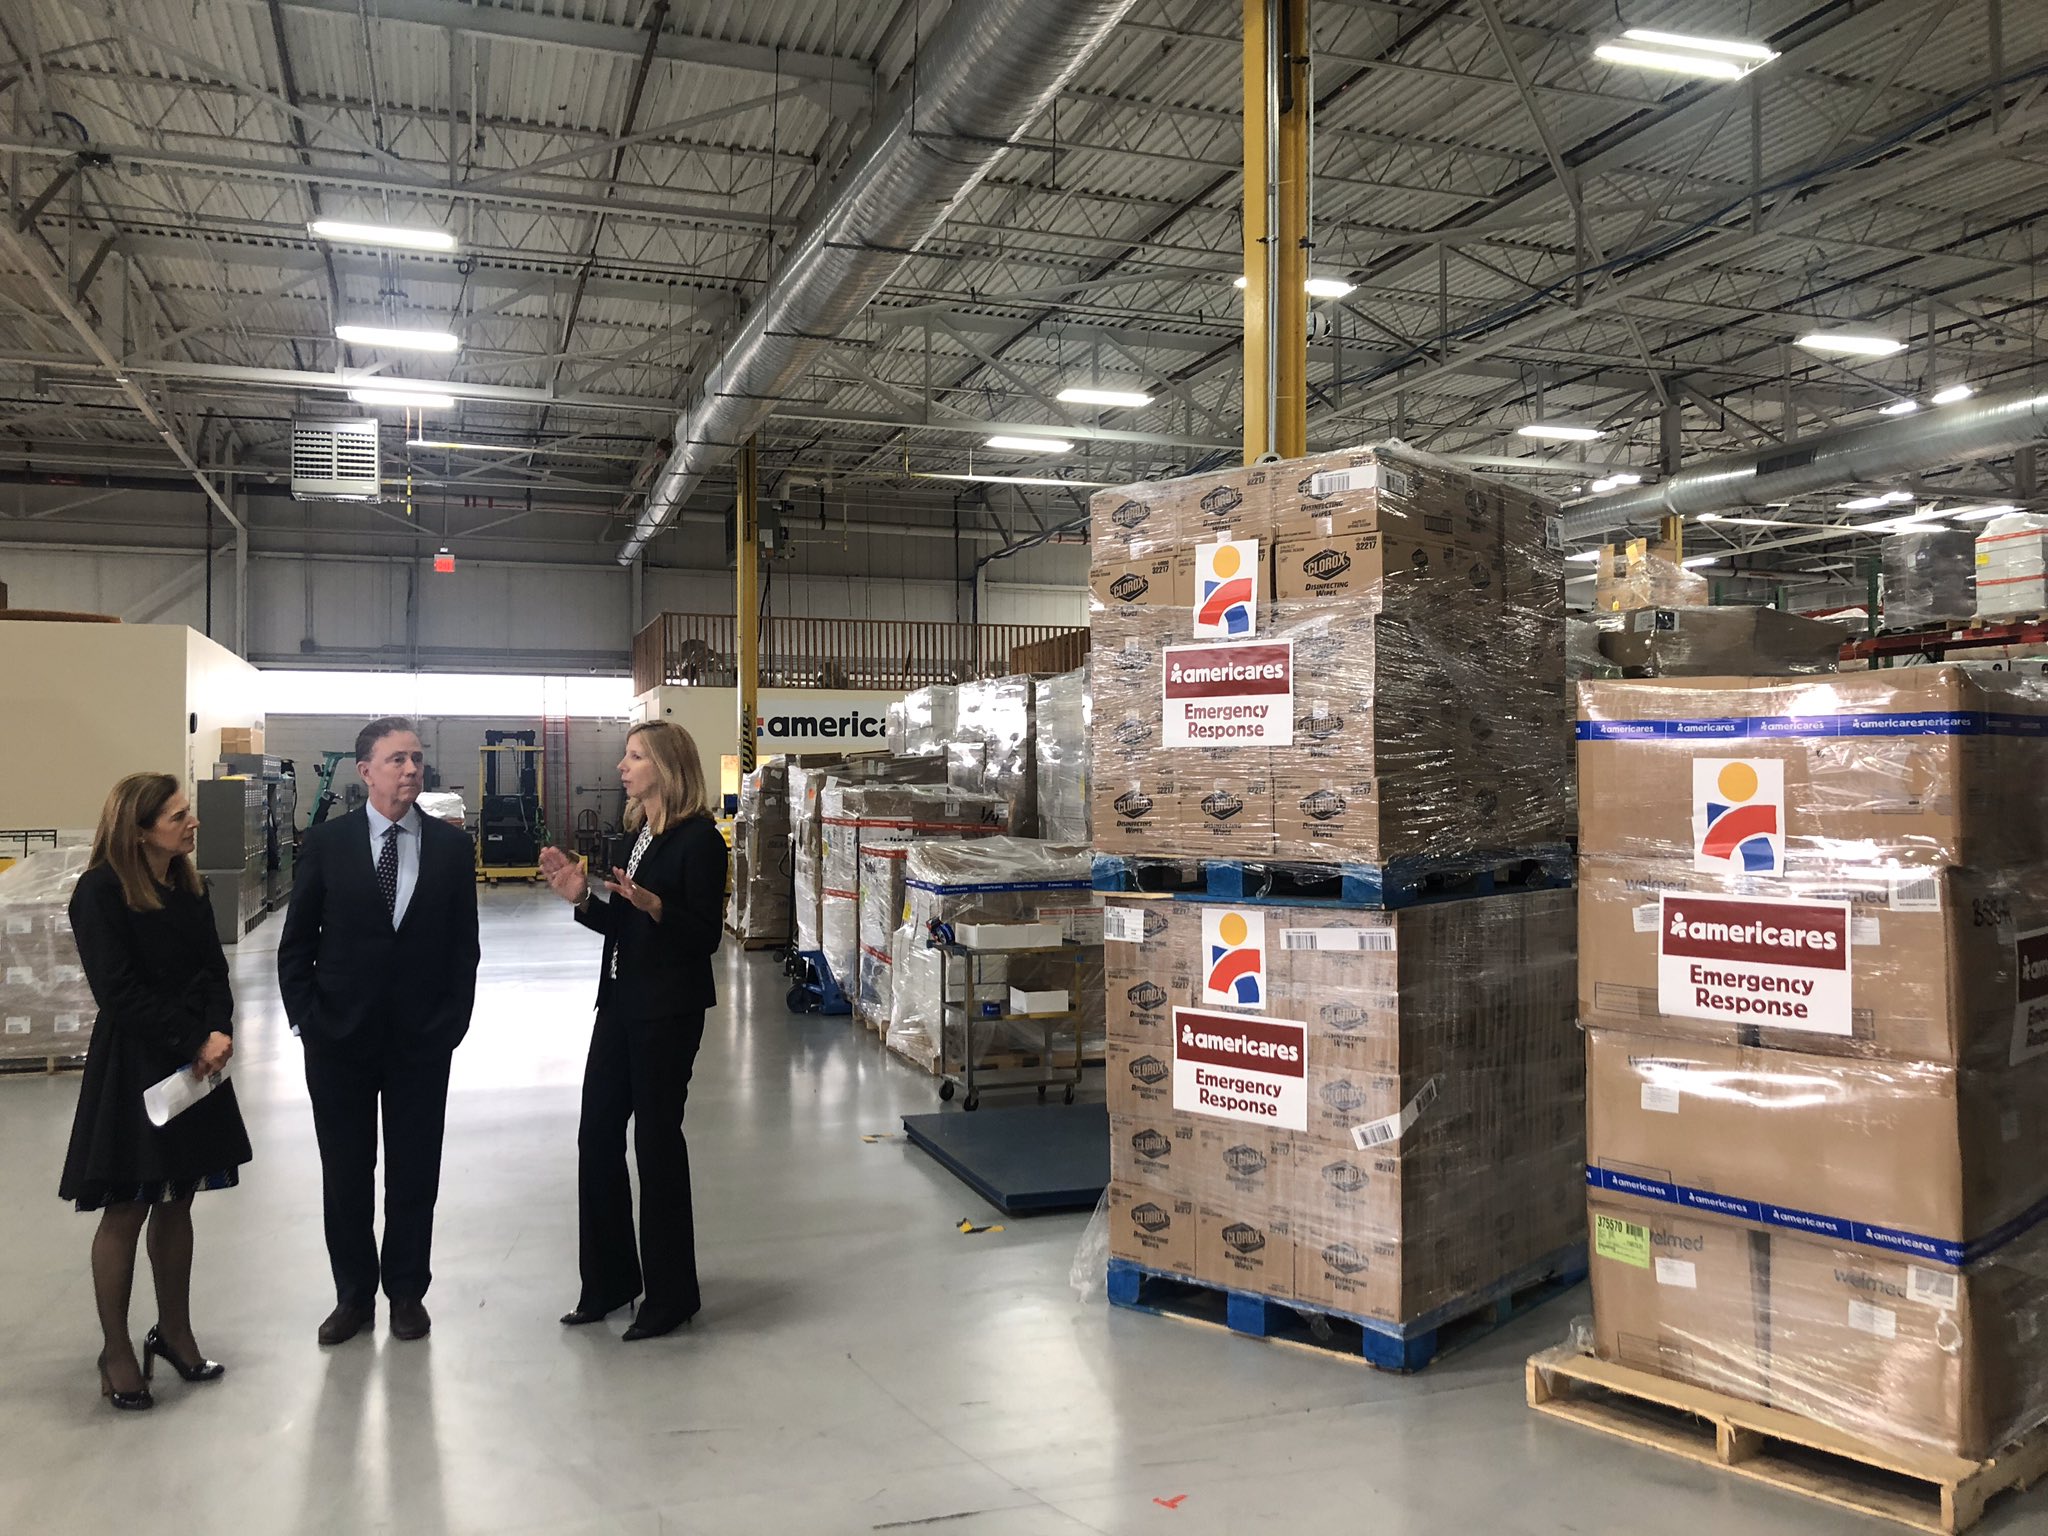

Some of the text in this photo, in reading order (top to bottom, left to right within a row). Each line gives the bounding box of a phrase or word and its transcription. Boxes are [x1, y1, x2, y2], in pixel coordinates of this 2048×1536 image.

[1203, 487, 1243, 514] CLOROX
[1355, 541, 1378, 551] 32217
[1152, 565, 1170, 575] 32217
[1307, 550, 1348, 577] CLOROX
[1113, 575, 1147, 600] CLOROX
[1305, 581, 1349, 591] DISINFECTING
[1183, 662, 1284, 684] americares
[1184, 703, 1269, 721] Emergency
[1188, 721, 1265, 740] Response
[1607, 725, 1655, 734] americares
[1685, 723, 1736, 733] americares
[1768, 721, 1825, 731] americares
[1688, 920, 1838, 951] americares
[1689, 963, 1815, 996] Emergency
[1131, 985, 1165, 1005] CLOROX
[1695, 987, 1809, 1018] Response
[1194, 1032, 1299, 1062] americares
[1133, 1061, 1166, 1077] CLOROX
[1195, 1067, 1282, 1099] Emergency
[1199, 1087, 1278, 1117] Response
[1134, 1136, 1168, 1151] CLOROX
[1617, 1178, 1666, 1196] americares
[1695, 1196, 1748, 1213] americares
[1134, 1208, 1168, 1226] CLOROX
[1597, 1215, 1623, 1233] 375570
[1780, 1213, 1838, 1232] americares
[1225, 1229, 1263, 1246] CLOROX
[1873, 1232, 1937, 1253] americares
